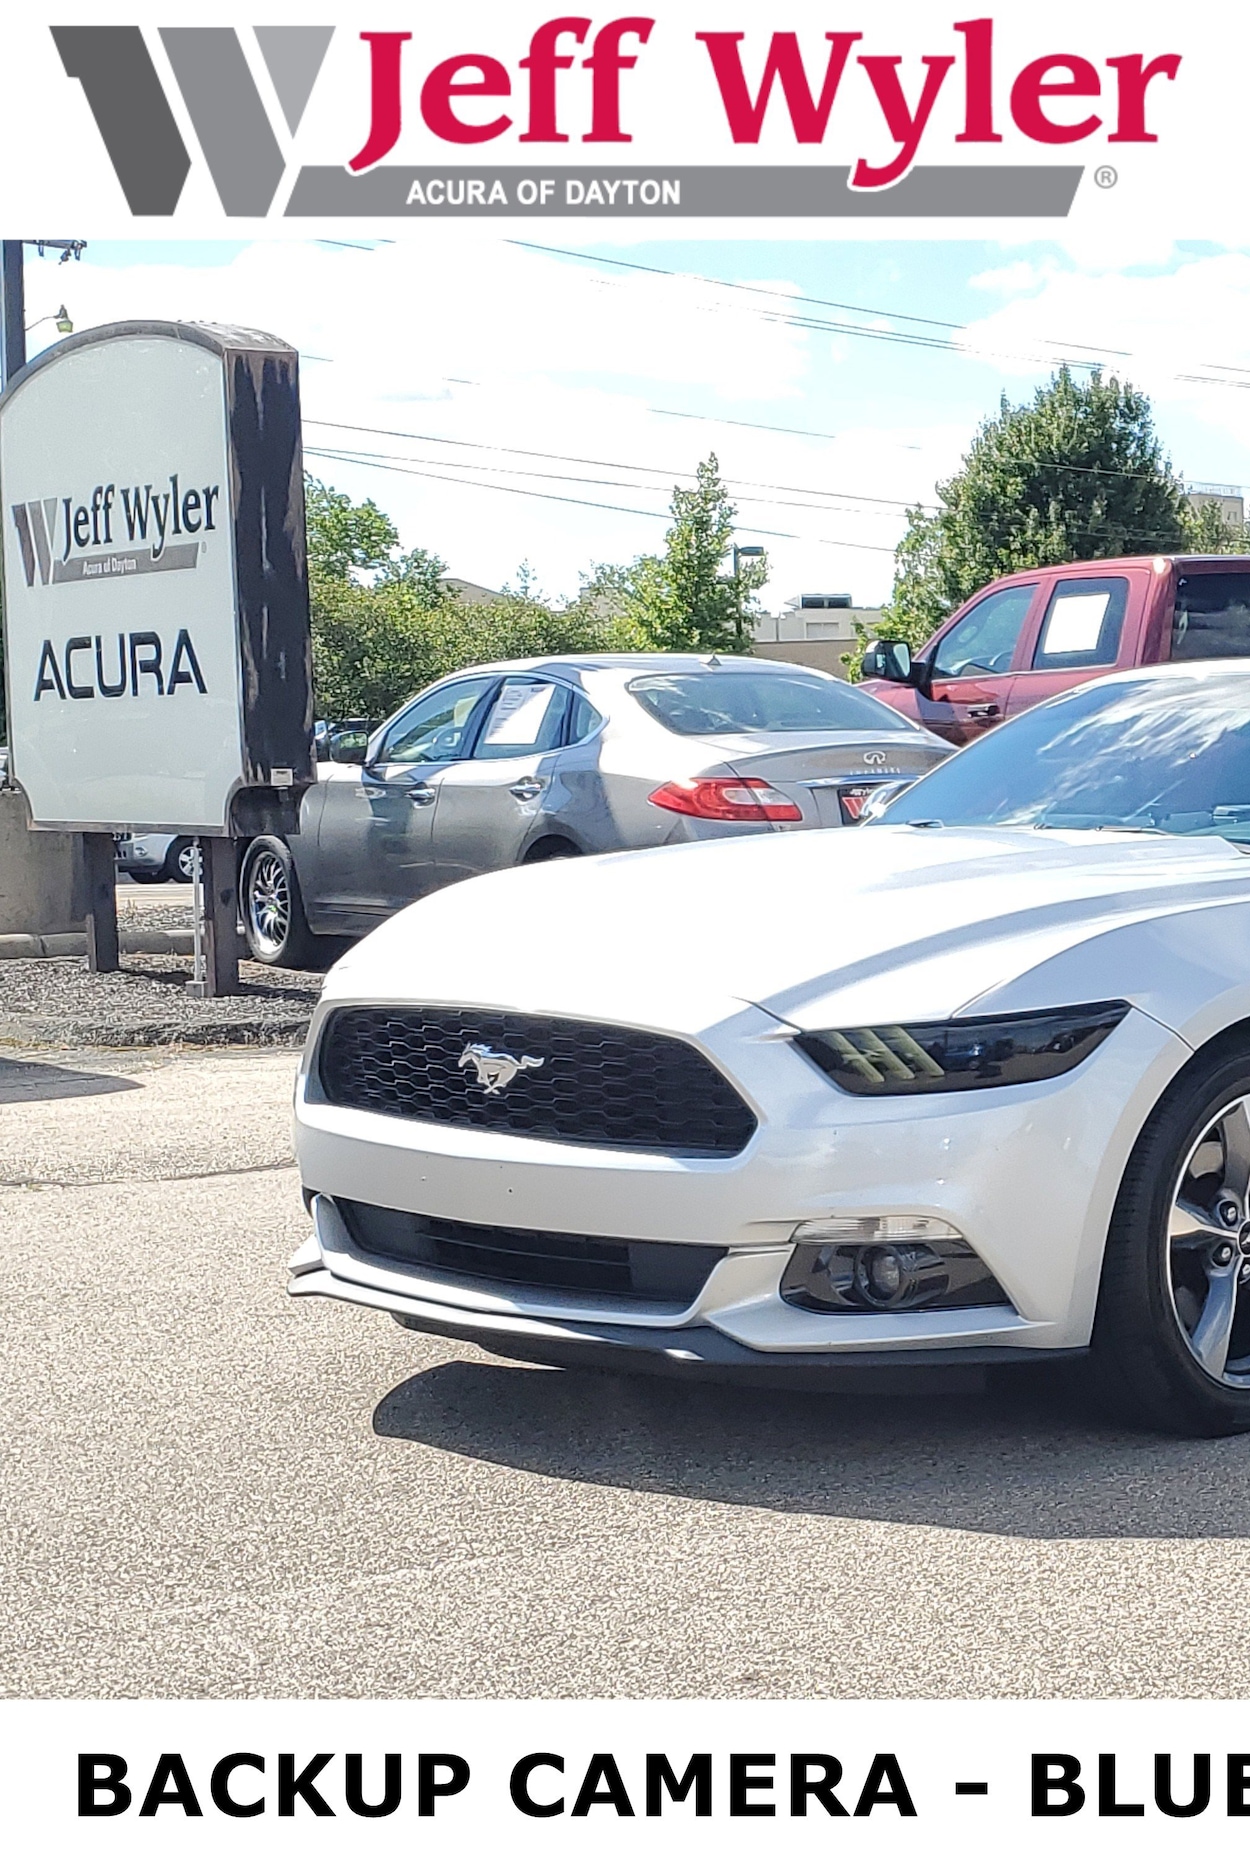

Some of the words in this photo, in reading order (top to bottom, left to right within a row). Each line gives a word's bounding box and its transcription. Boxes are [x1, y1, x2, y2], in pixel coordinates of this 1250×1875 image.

[62, 483, 115, 562] Jeff
[120, 474, 219, 559] Wyler
[33, 629, 208, 701] ACURA
